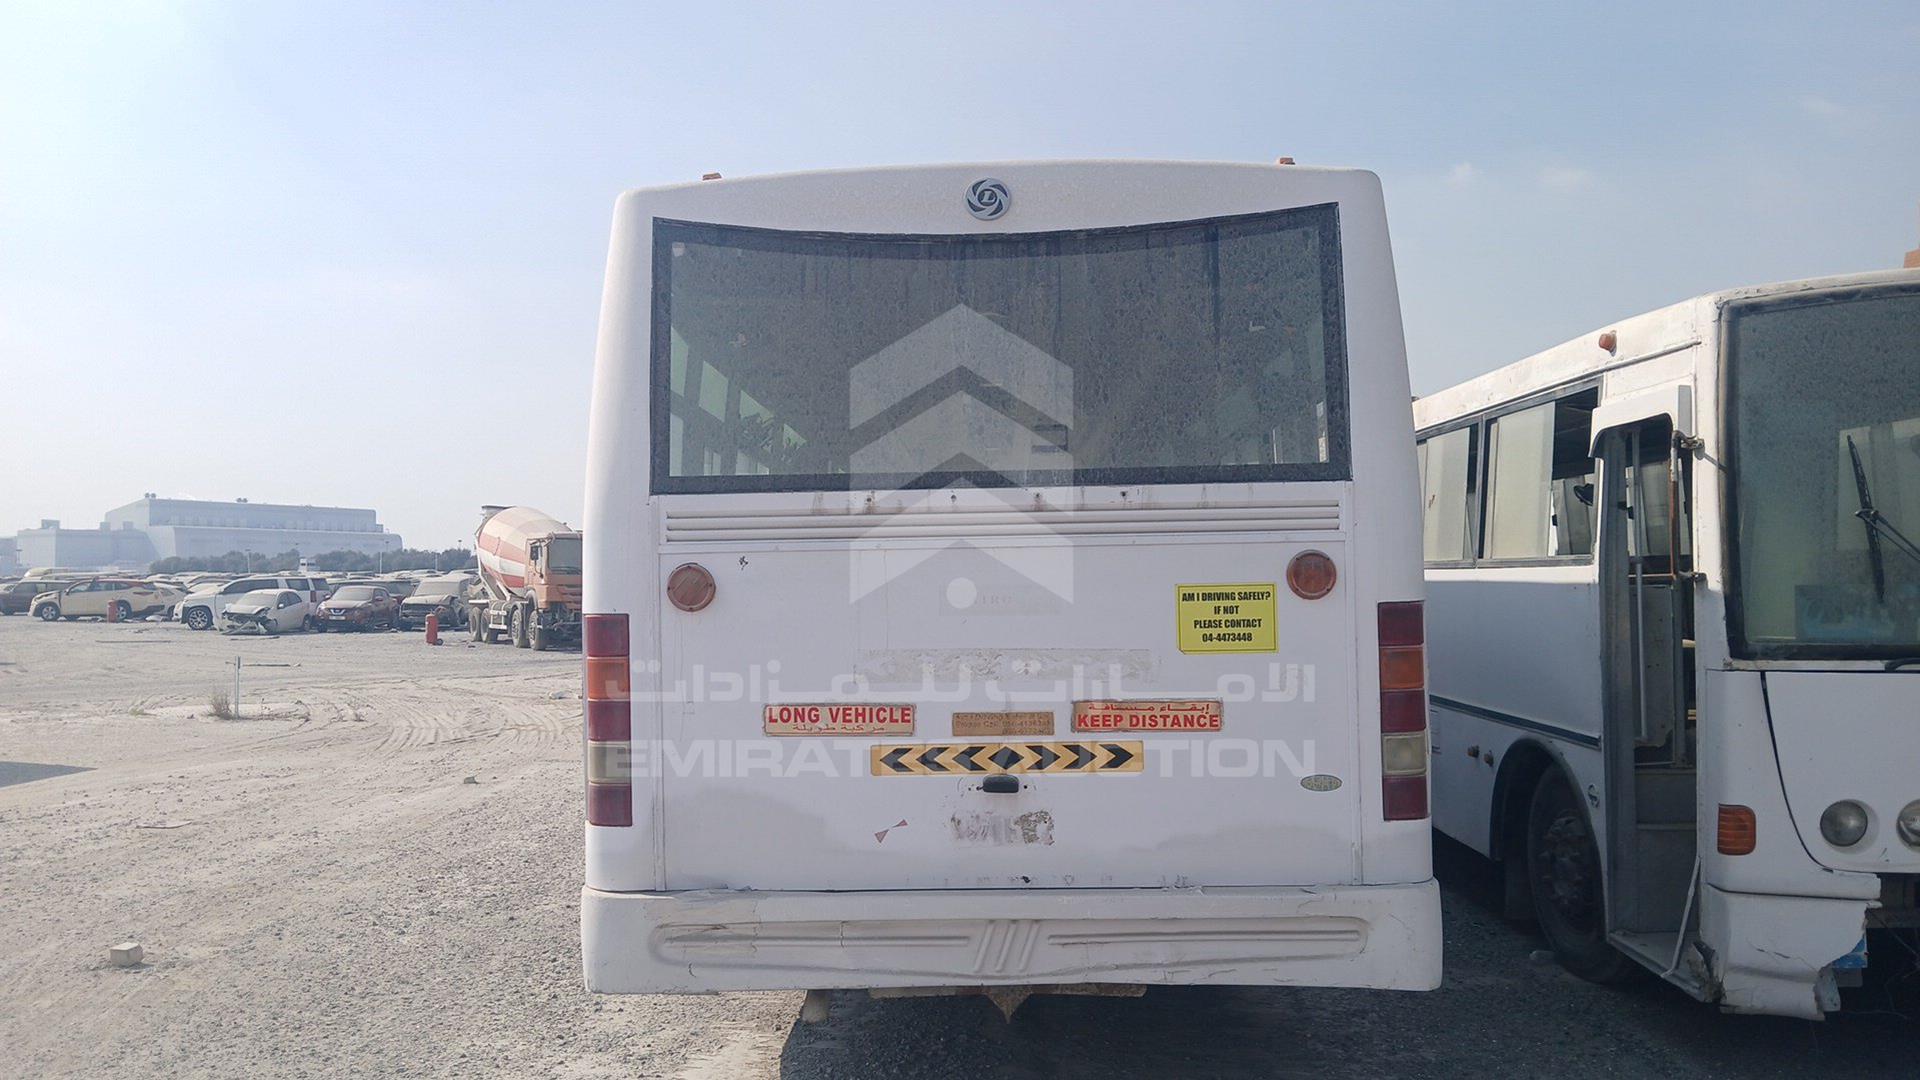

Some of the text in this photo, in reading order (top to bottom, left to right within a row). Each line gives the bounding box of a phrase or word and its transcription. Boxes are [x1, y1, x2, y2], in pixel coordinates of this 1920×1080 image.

[1182, 592, 1195, 602] AM
[1201, 591, 1236, 601] DRIVING
[1237, 591, 1271, 600] SAFELY?
[1214, 605, 1240, 615] IF NOT
[1193, 618, 1262, 629] PLEASE CONTACT
[1202, 632, 1253, 642] 04-4473448
[768, 707, 911, 724] LONG VEHICLE
[1077, 714, 1219, 728] KEEP DISTANCE
